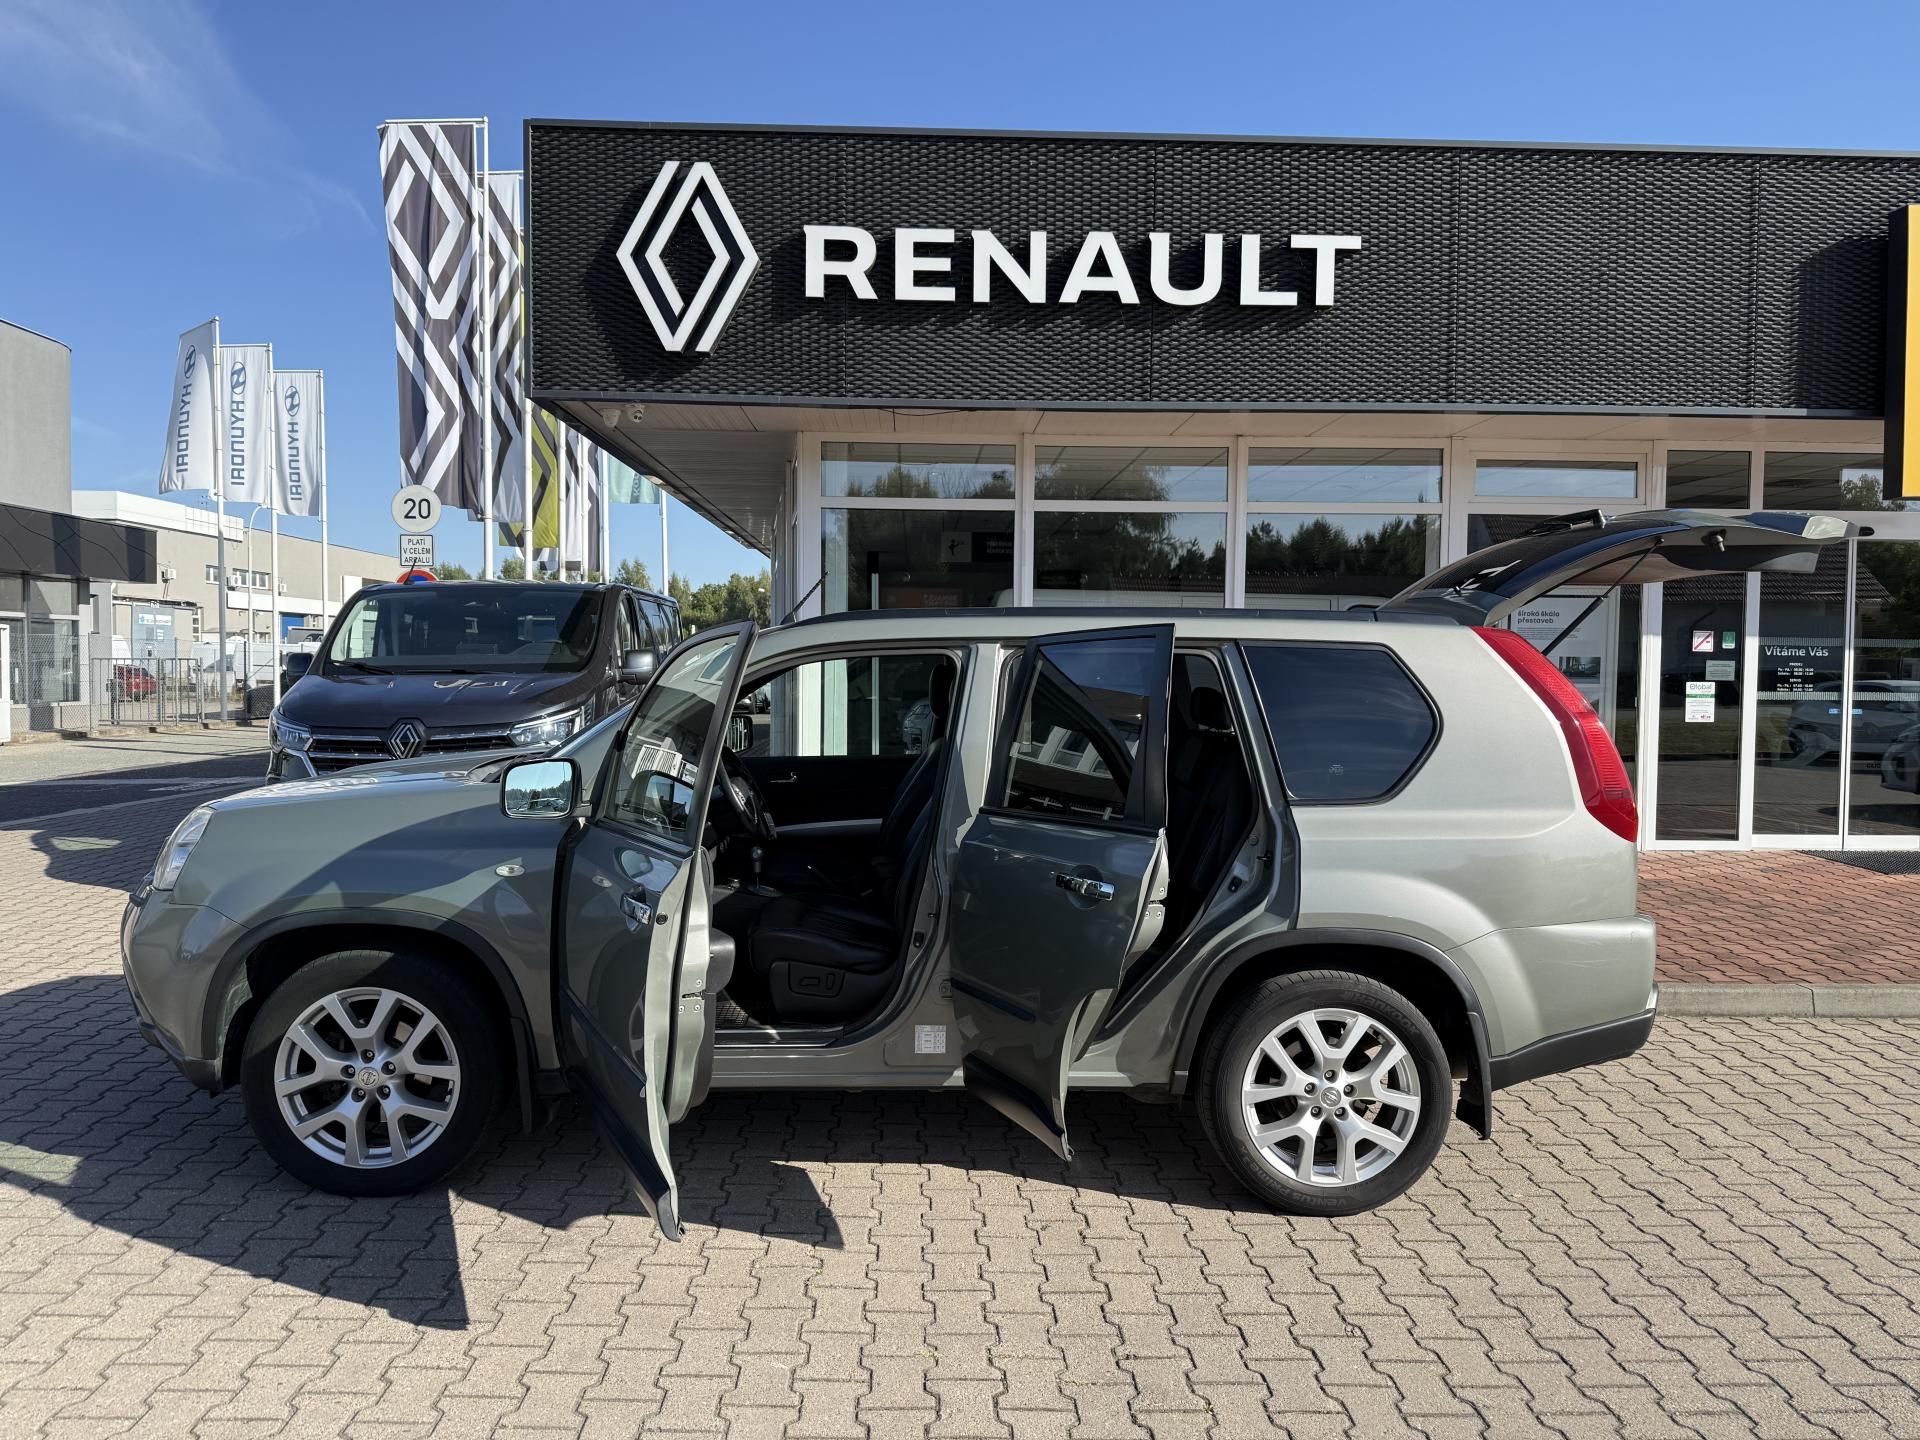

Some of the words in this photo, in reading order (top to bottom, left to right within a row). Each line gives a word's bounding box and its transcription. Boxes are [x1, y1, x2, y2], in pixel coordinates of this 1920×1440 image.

[803, 223, 1363, 307] RENAULT
[404, 498, 430, 520] 20
[408, 538, 426, 546] PLATÍ
[1764, 645, 1806, 656] Vítáme
[1808, 646, 1829, 657] Vás
